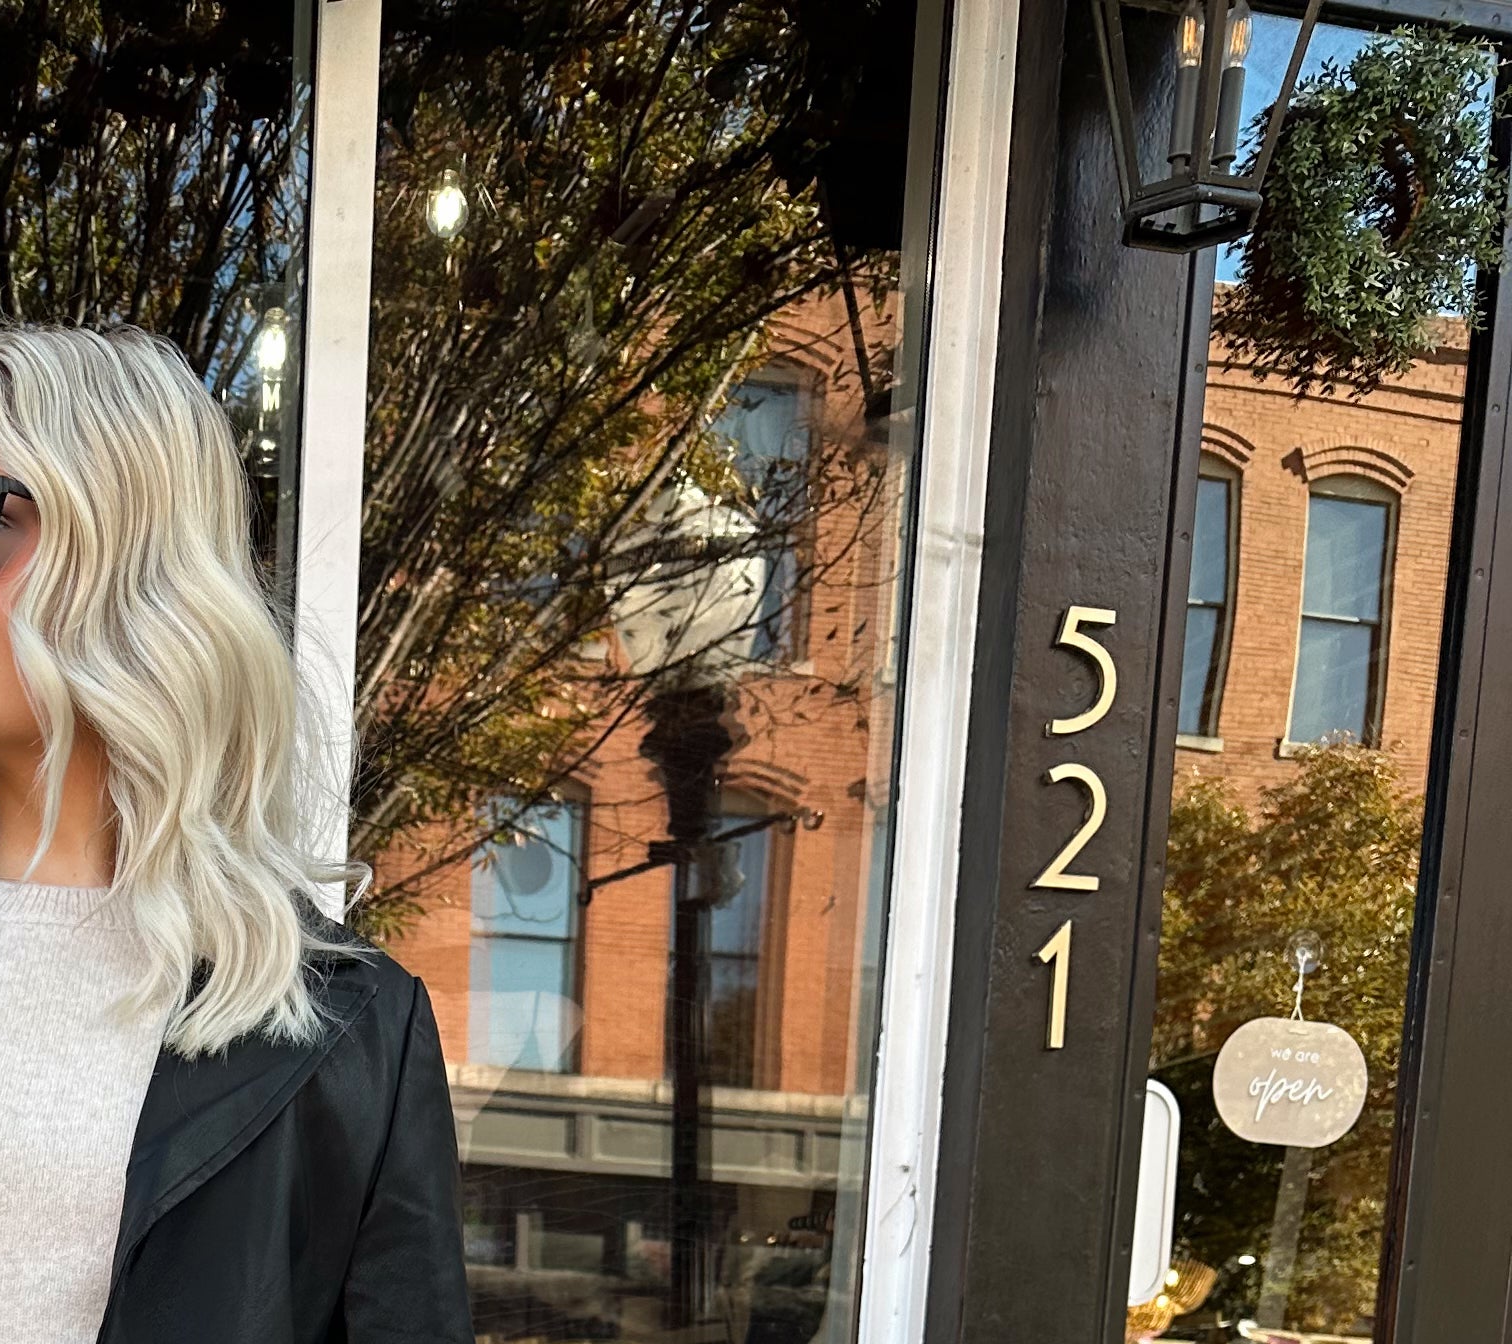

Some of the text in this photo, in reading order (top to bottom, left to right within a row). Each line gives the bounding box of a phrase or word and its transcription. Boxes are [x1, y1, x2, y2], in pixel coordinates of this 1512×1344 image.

[1029, 605, 1118, 1050] 521
[1270, 1047, 1320, 1064] we are
[1249, 1068, 1334, 1122] open
